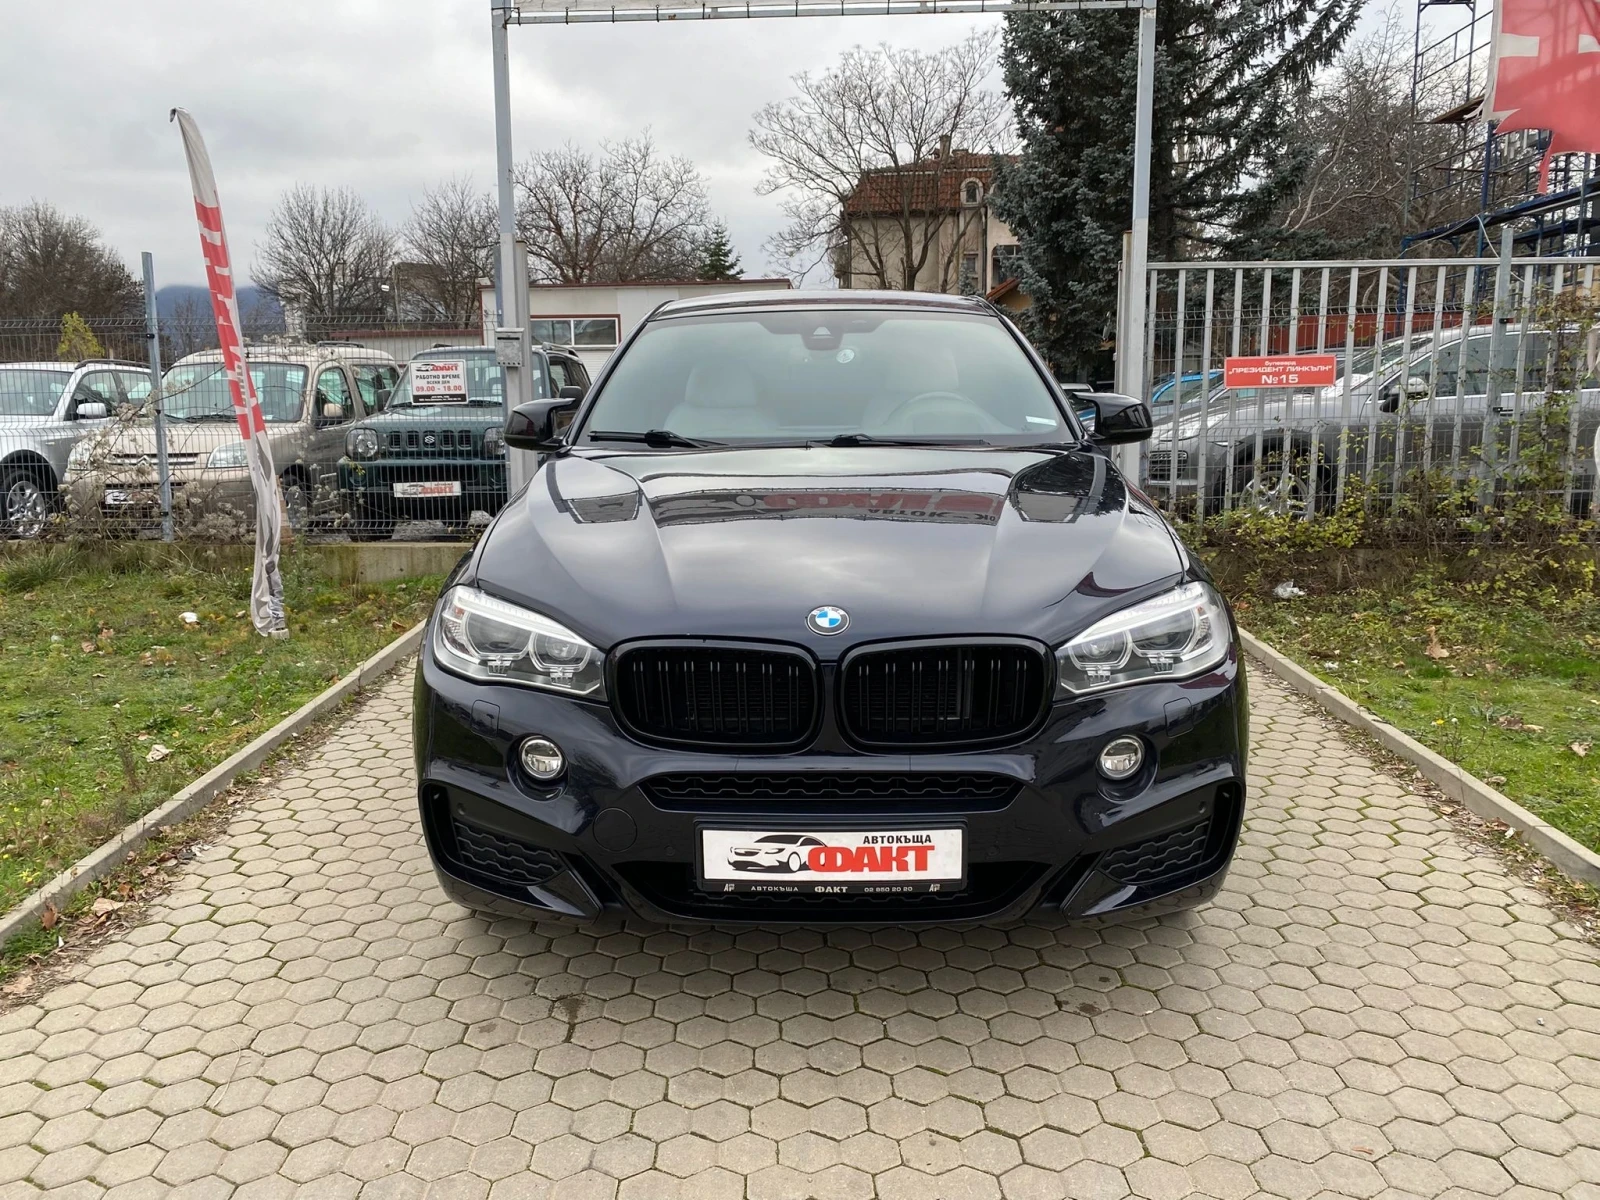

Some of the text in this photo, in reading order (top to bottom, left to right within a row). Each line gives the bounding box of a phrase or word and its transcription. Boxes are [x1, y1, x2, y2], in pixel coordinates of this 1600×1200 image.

[862, 834, 932, 845] АВТОКЪЩА
[806, 845, 936, 873] ФАКТ
[814, 885, 848, 893] ФАКТ
